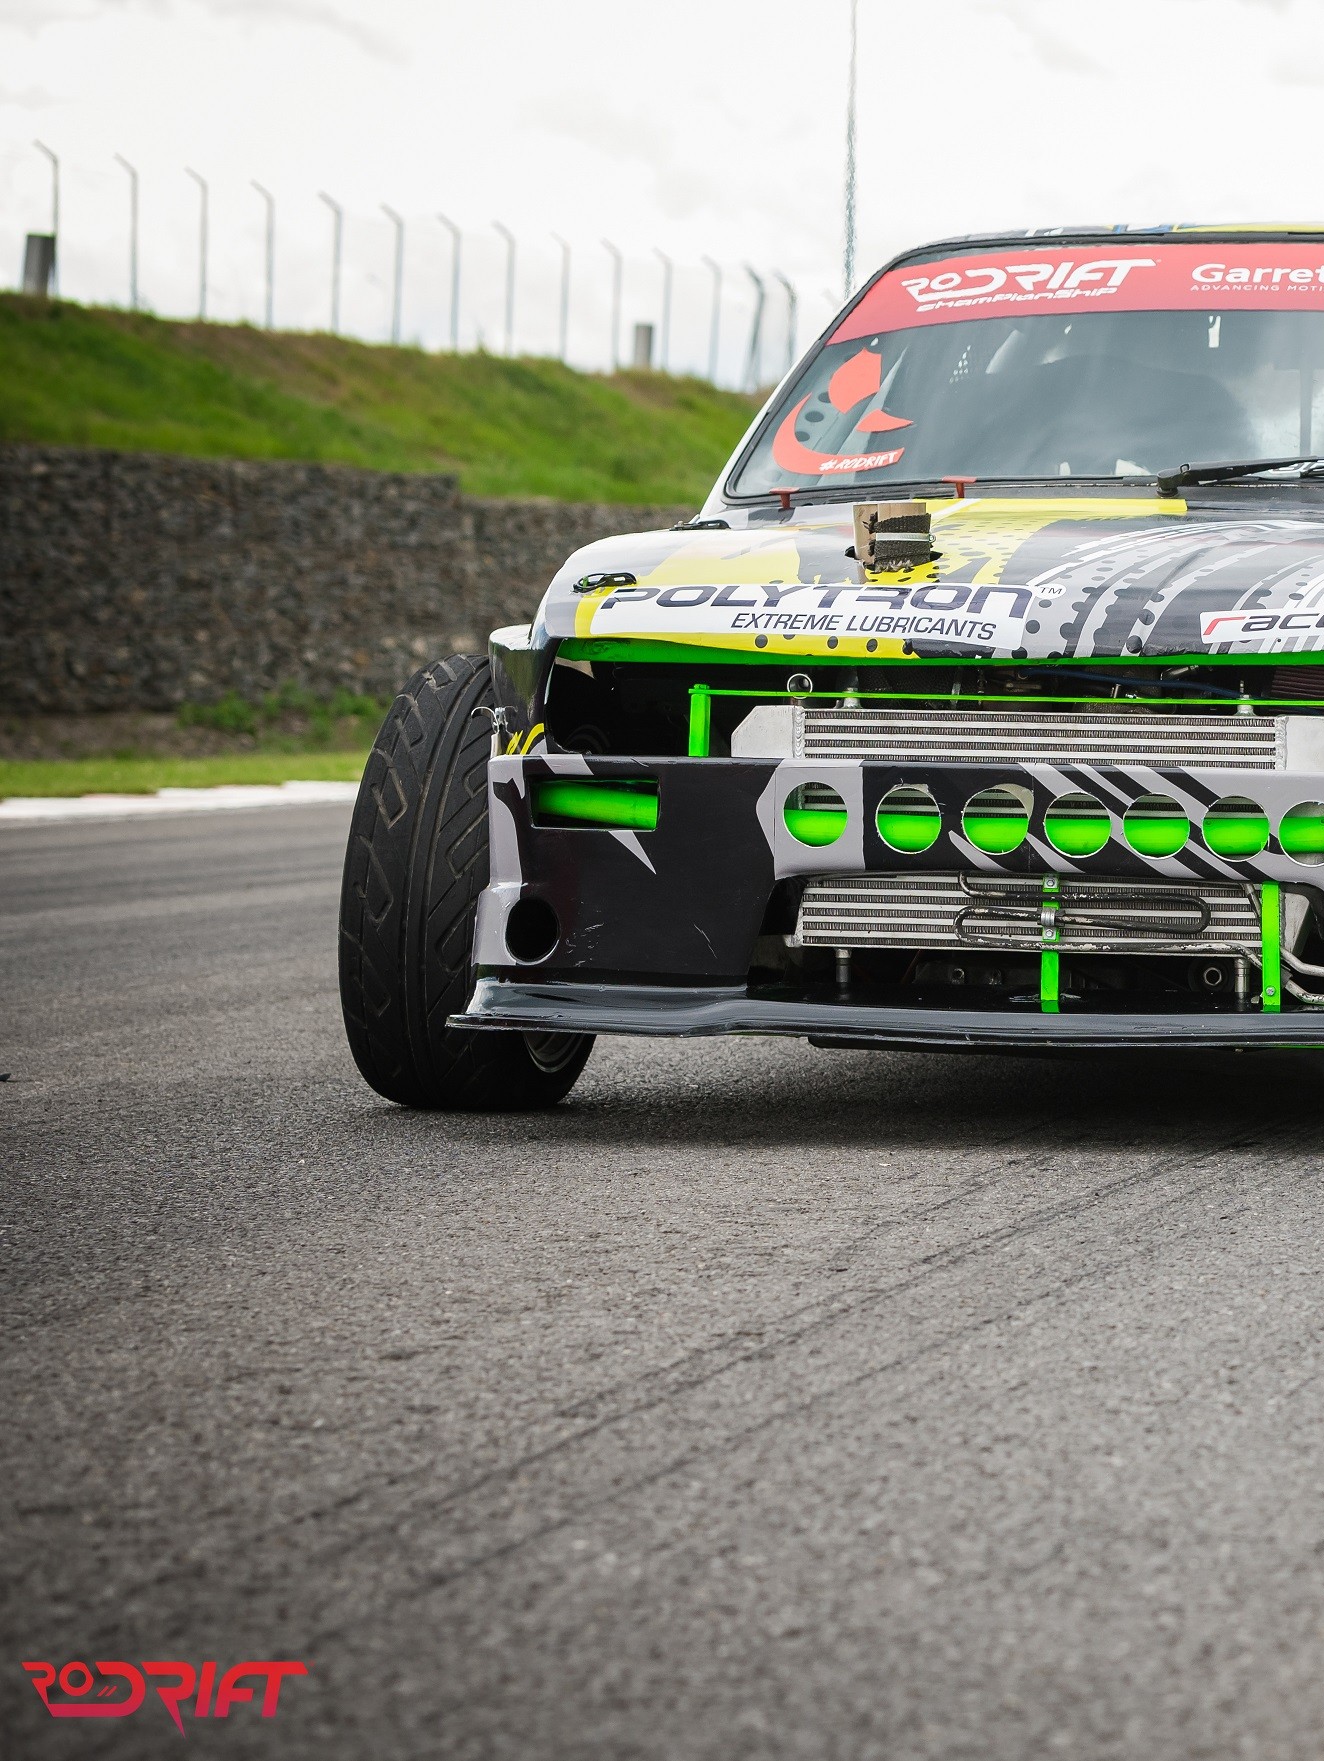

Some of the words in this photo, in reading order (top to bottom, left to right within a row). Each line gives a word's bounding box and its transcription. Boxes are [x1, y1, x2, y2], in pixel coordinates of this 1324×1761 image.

[901, 259, 1157, 303] RODRIFT
[1190, 284, 1279, 292] ADVANCING
[819, 451, 898, 471] #RODRIFT
[600, 585, 1038, 618] POLYTRON
[731, 613, 844, 631] EXTREME
[846, 615, 997, 641] LUBRICANTS
